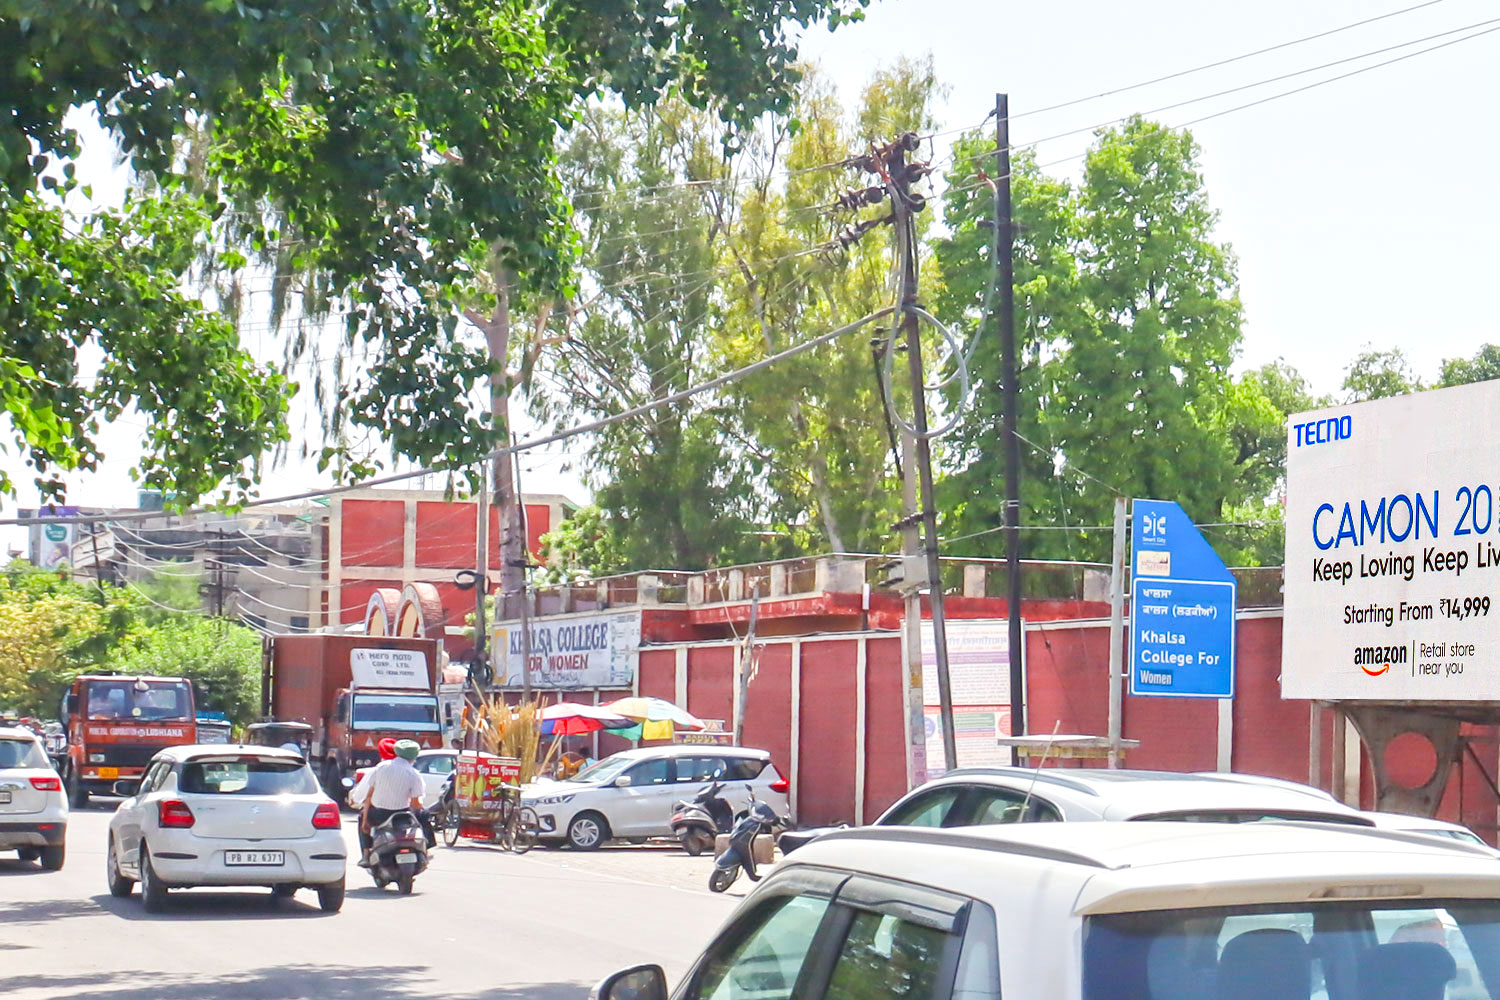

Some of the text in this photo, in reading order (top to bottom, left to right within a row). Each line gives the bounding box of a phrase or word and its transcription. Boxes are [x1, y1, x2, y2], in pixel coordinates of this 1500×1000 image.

[1293, 415, 1352, 448] TECNO
[1312, 484, 1492, 550] CAMON 20
[1313, 557, 1353, 585] Keep
[1360, 550, 1415, 581] Loving
[1423, 547, 1468, 576] Keep
[1343, 595, 1491, 627] Starting From ₹14,999
[557, 622, 609, 652] COLLEGE
[1141, 630, 1186, 645] Khalsa
[1141, 650, 1220, 667] College For
[1354, 643, 1407, 665] amazon
[1420, 641, 1475, 658] Retail store
[527, 653, 590, 672] OR WOMEN
[1419, 662, 1464, 678] near you
[1140, 670, 1172, 685] Women
[145, 728, 184, 737] LUDHIANA
